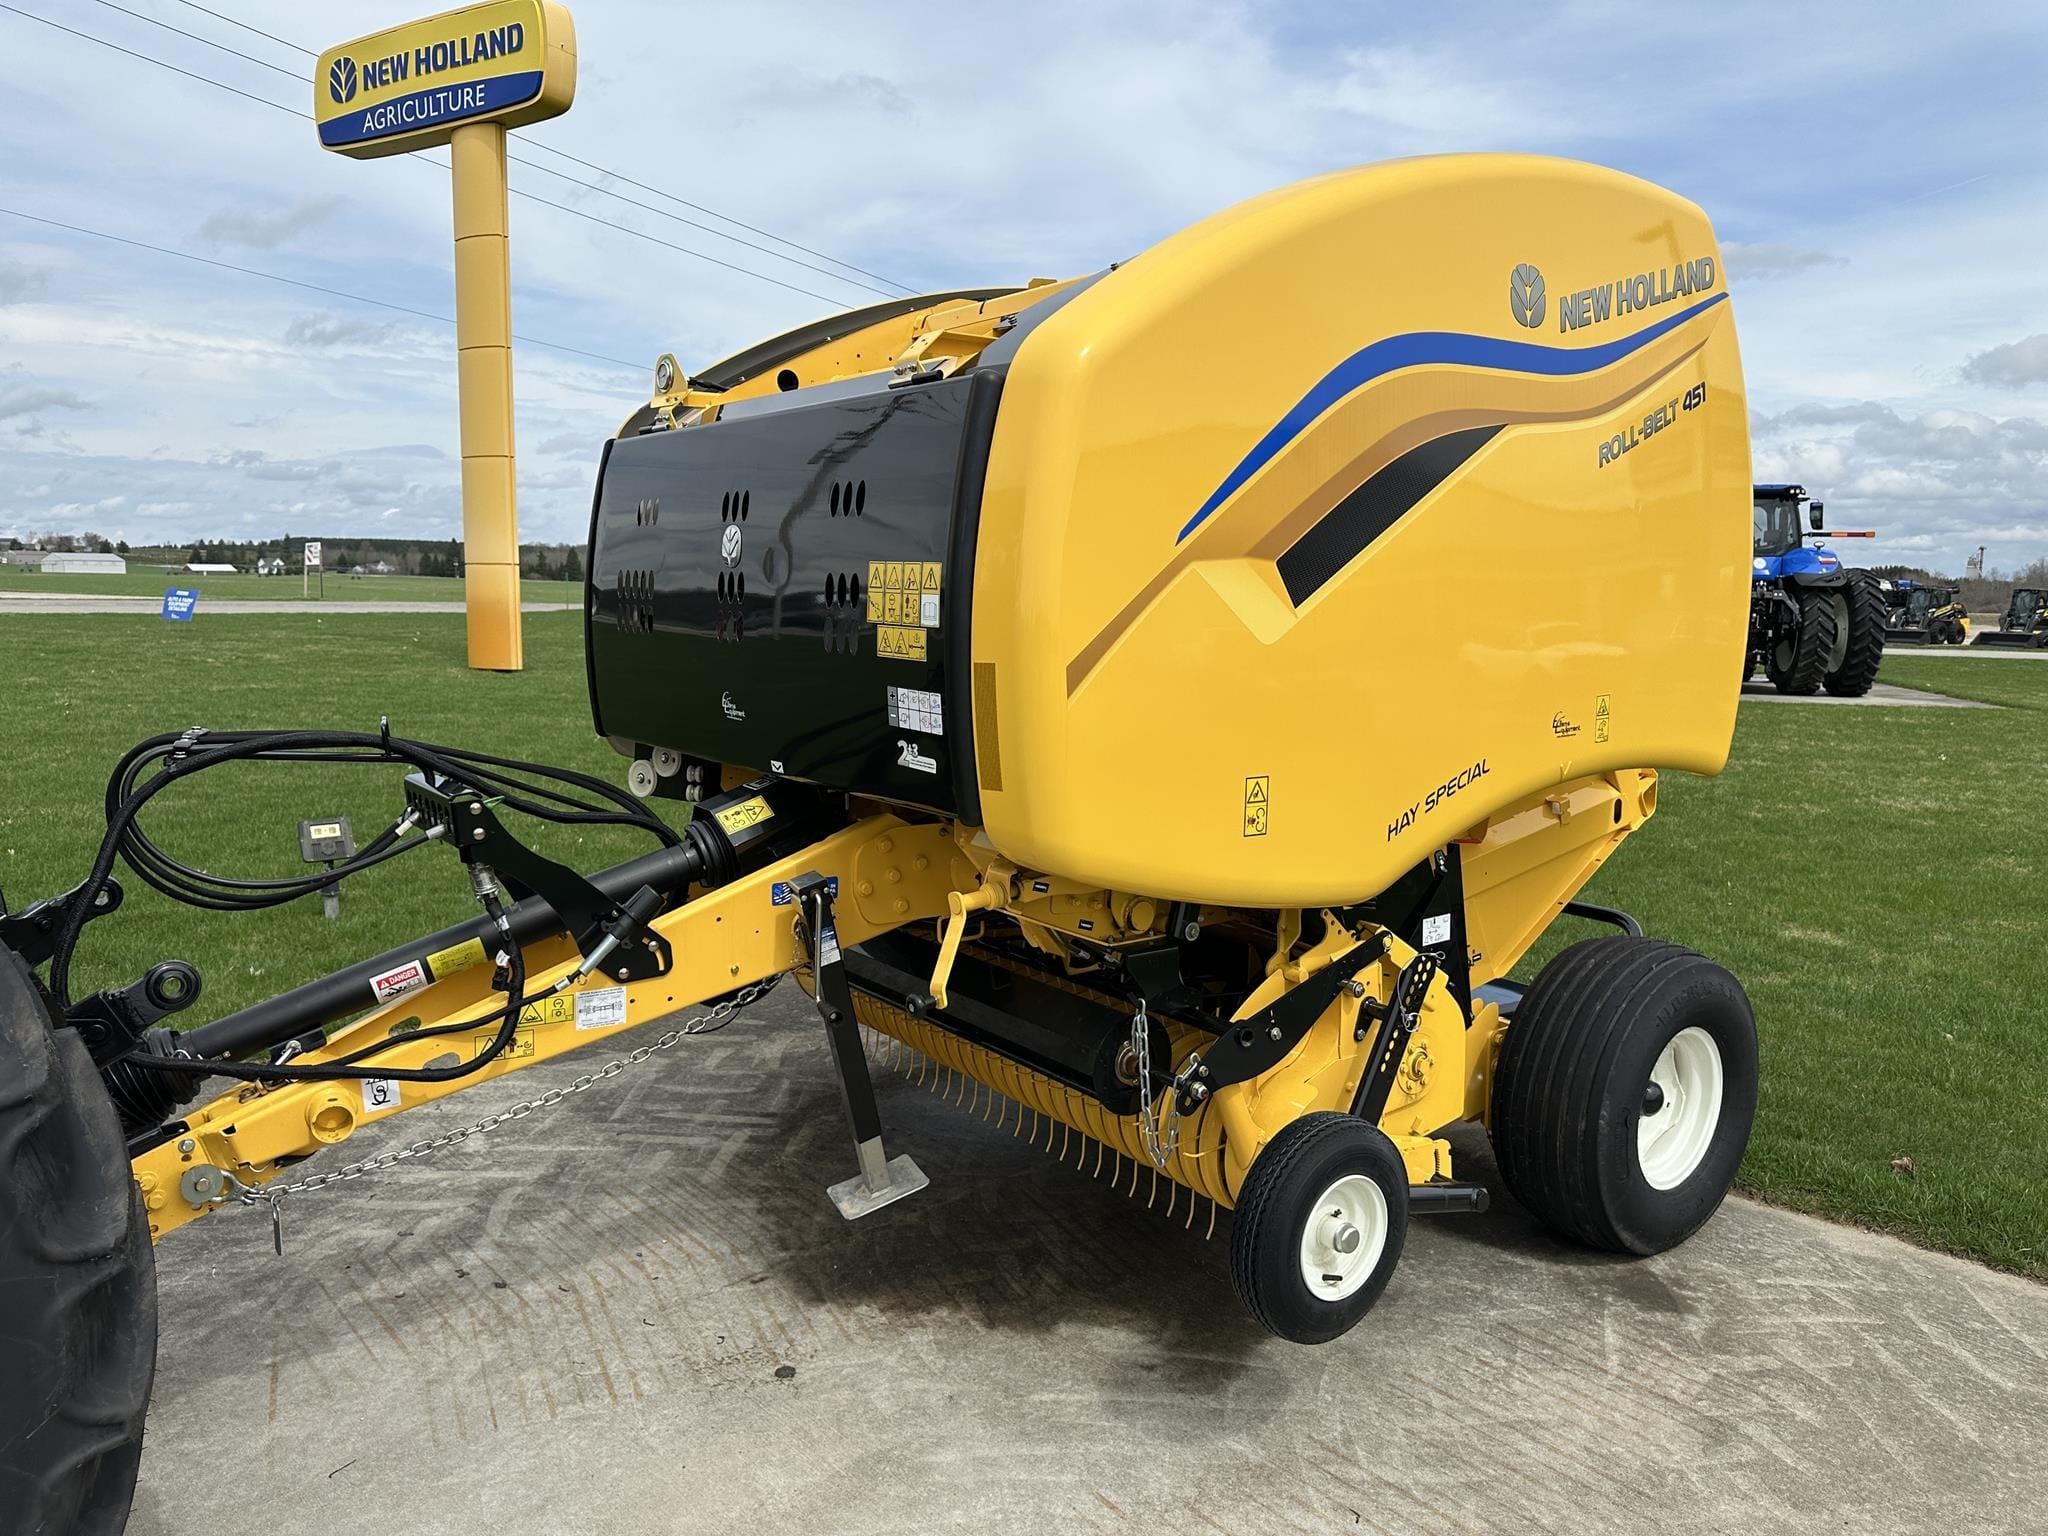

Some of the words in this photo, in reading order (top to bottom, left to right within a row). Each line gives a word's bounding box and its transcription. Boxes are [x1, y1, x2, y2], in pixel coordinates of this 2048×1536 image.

[363, 51, 410, 92] NEW
[415, 22, 524, 77] HOLLAND
[363, 84, 485, 133] AGRICULTURE
[1560, 283, 1613, 333] NEW
[1616, 256, 1715, 317] HOLLAND
[1599, 398, 1679, 468] ROLL-BELT
[1682, 382, 1706, 411] 451
[1387, 802, 1421, 842] HAY
[1424, 758, 1490, 814] SPECIAL
[388, 967, 418, 985] DANGER
